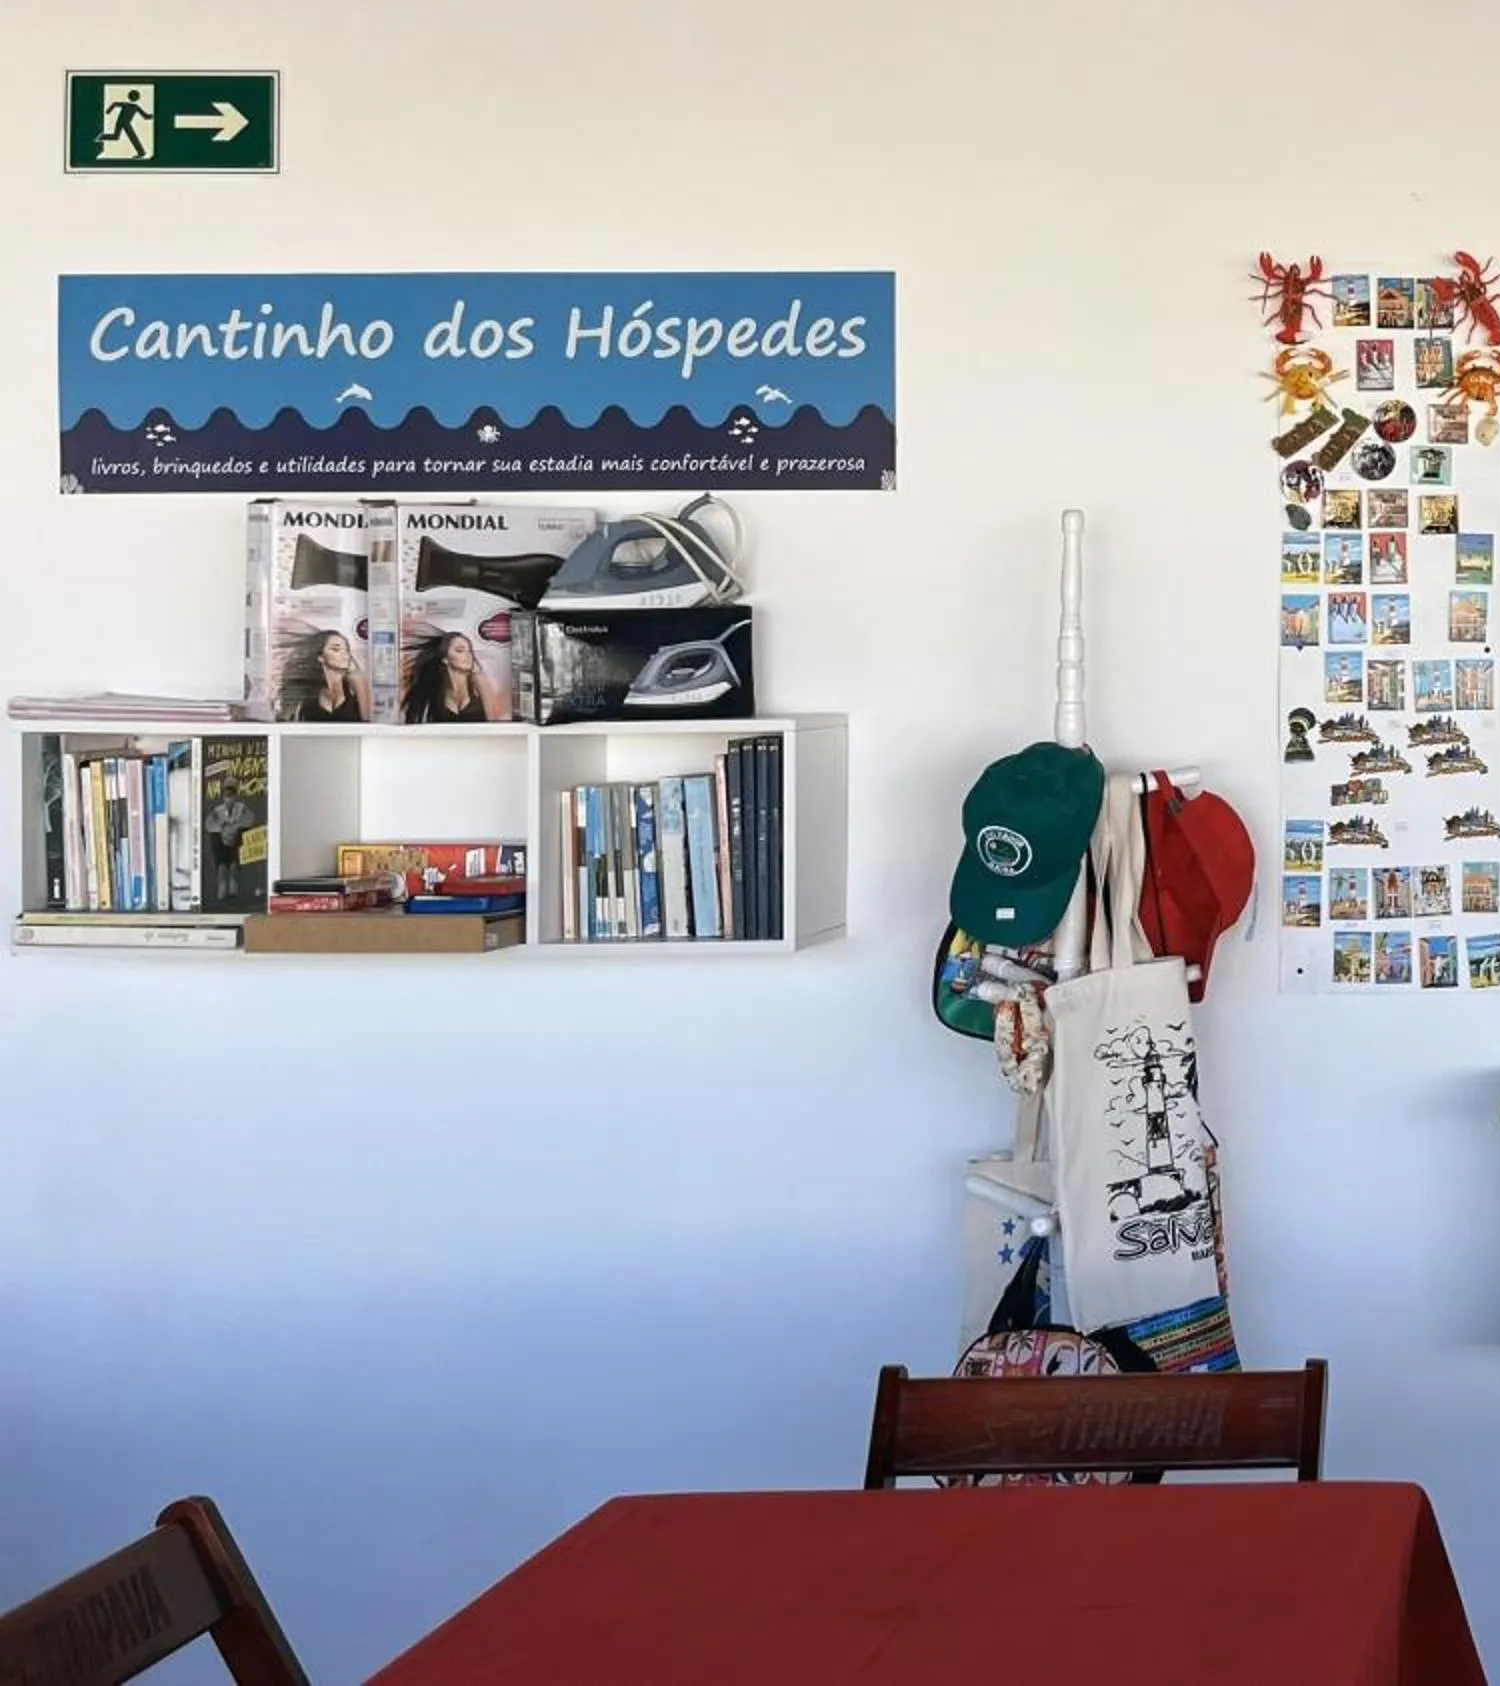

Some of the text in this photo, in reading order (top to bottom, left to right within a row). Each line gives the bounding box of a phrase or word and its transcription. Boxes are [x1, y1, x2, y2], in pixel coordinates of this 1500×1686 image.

[89, 299, 868, 380] Cantinho dos Hóspedes
[91, 453, 866, 479] livros, brinquedos e utilidades para tornar sua estadia mais confortável e prazerosa
[284, 512, 368, 530] MONDI
[406, 513, 510, 531] MONDIAL
